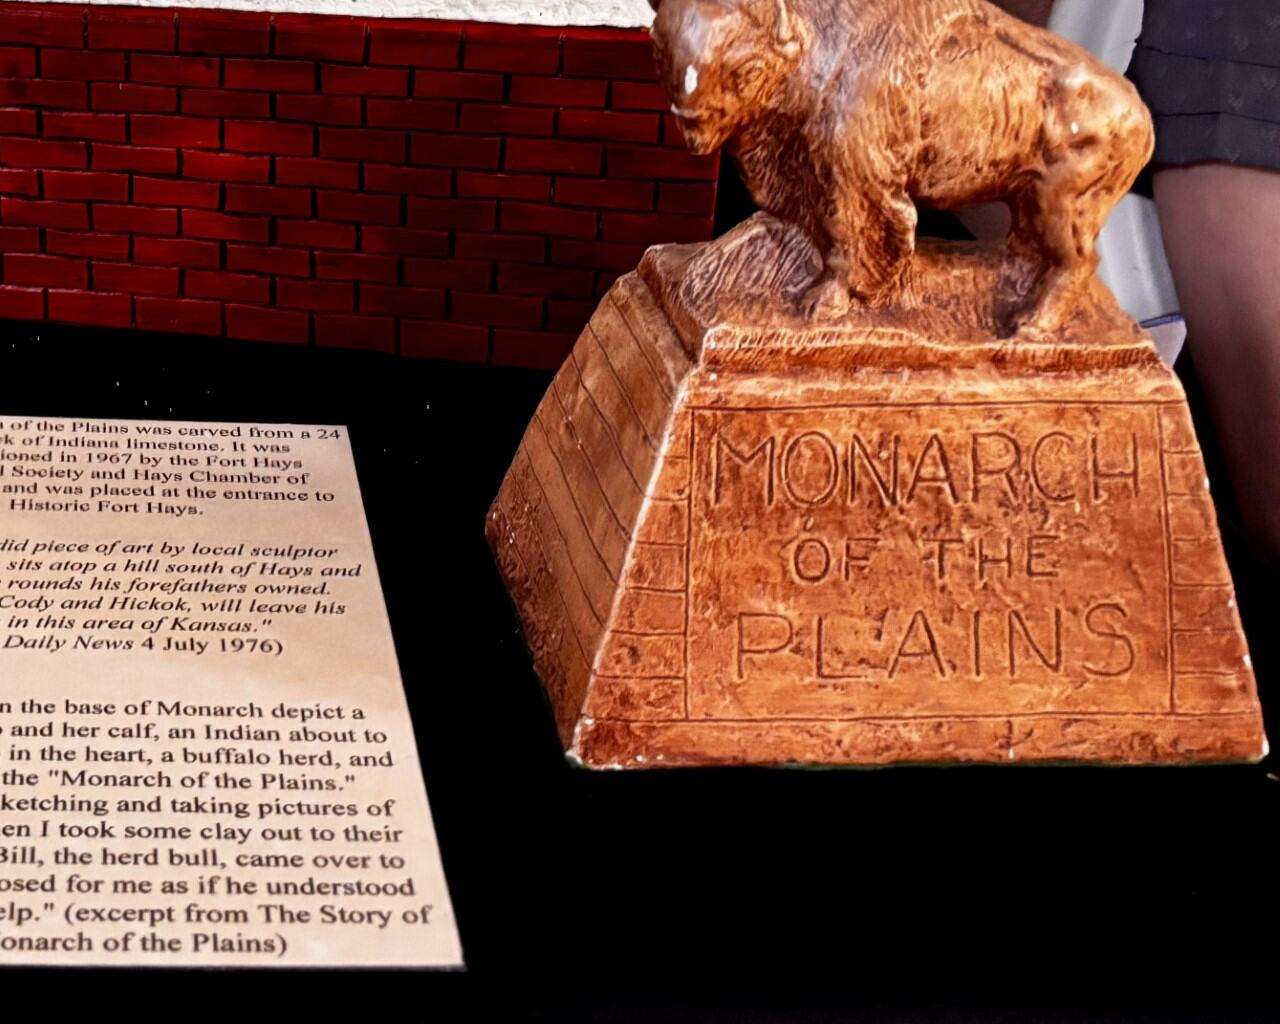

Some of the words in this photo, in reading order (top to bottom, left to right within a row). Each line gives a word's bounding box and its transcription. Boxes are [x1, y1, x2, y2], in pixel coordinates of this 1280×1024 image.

[710, 430, 1139, 506] MONARCH
[9, 497, 90, 512] Historic
[97, 499, 139, 513] Fort
[145, 500, 204, 518] Hays.
[793, 536, 881, 581] OF
[924, 534, 1060, 579] THE
[1, 633, 67, 653] Daily
[71, 634, 134, 650] News
[140, 635, 154, 651] 4
[161, 635, 209, 656] July
[219, 637, 284, 656] 1976)
[734, 601, 1136, 678] PLAINS
[20, 697, 56, 714] the
[63, 698, 116, 715] base
[122, 698, 152, 716] of
[156, 699, 263, 718] Monarch
[270, 701, 345, 723] depict
[350, 707, 366, 720] a
[9, 720, 53, 738] and
[61, 720, 101, 738] her
[106, 721, 160, 742] calf,
[166, 727, 196, 740] an
[204, 723, 281, 742] Indian
[288, 725, 357, 743] about
[362, 728, 388, 744] to
[1, 767, 39, 786] the
[48, 768, 172, 788] "Monarch
[179, 770, 210, 789] of
[213, 771, 252, 790] the
[260, 772, 355, 791] Plains."
[115, 794, 162, 813] and
[169, 795, 251, 819] taking
[257, 797, 359, 820] pictures
[365, 798, 396, 817] of
[40, 819, 49, 838] I
[57, 819, 116, 839] took
[123, 825, 192, 840] some
[199, 821, 252, 845] clay
[260, 826, 302, 841] out
[309, 826, 335, 842] to
[342, 823, 403, 843] their
[52, 845, 93, 865] the
[101, 846, 159, 866] herd
[167, 847, 227, 870] bull,
[234, 853, 304, 868] came
[311, 854, 371, 869] over
[378, 853, 405, 869] to
[63, 903, 175, 927] (excerpt
[183, 902, 249, 924] from
[256, 903, 311, 924] The
[318, 904, 392, 929] Story
[400, 904, 432, 924] of
[102, 930, 136, 952] of
[139, 931, 182, 952] the
[192, 931, 288, 956] Plains)
